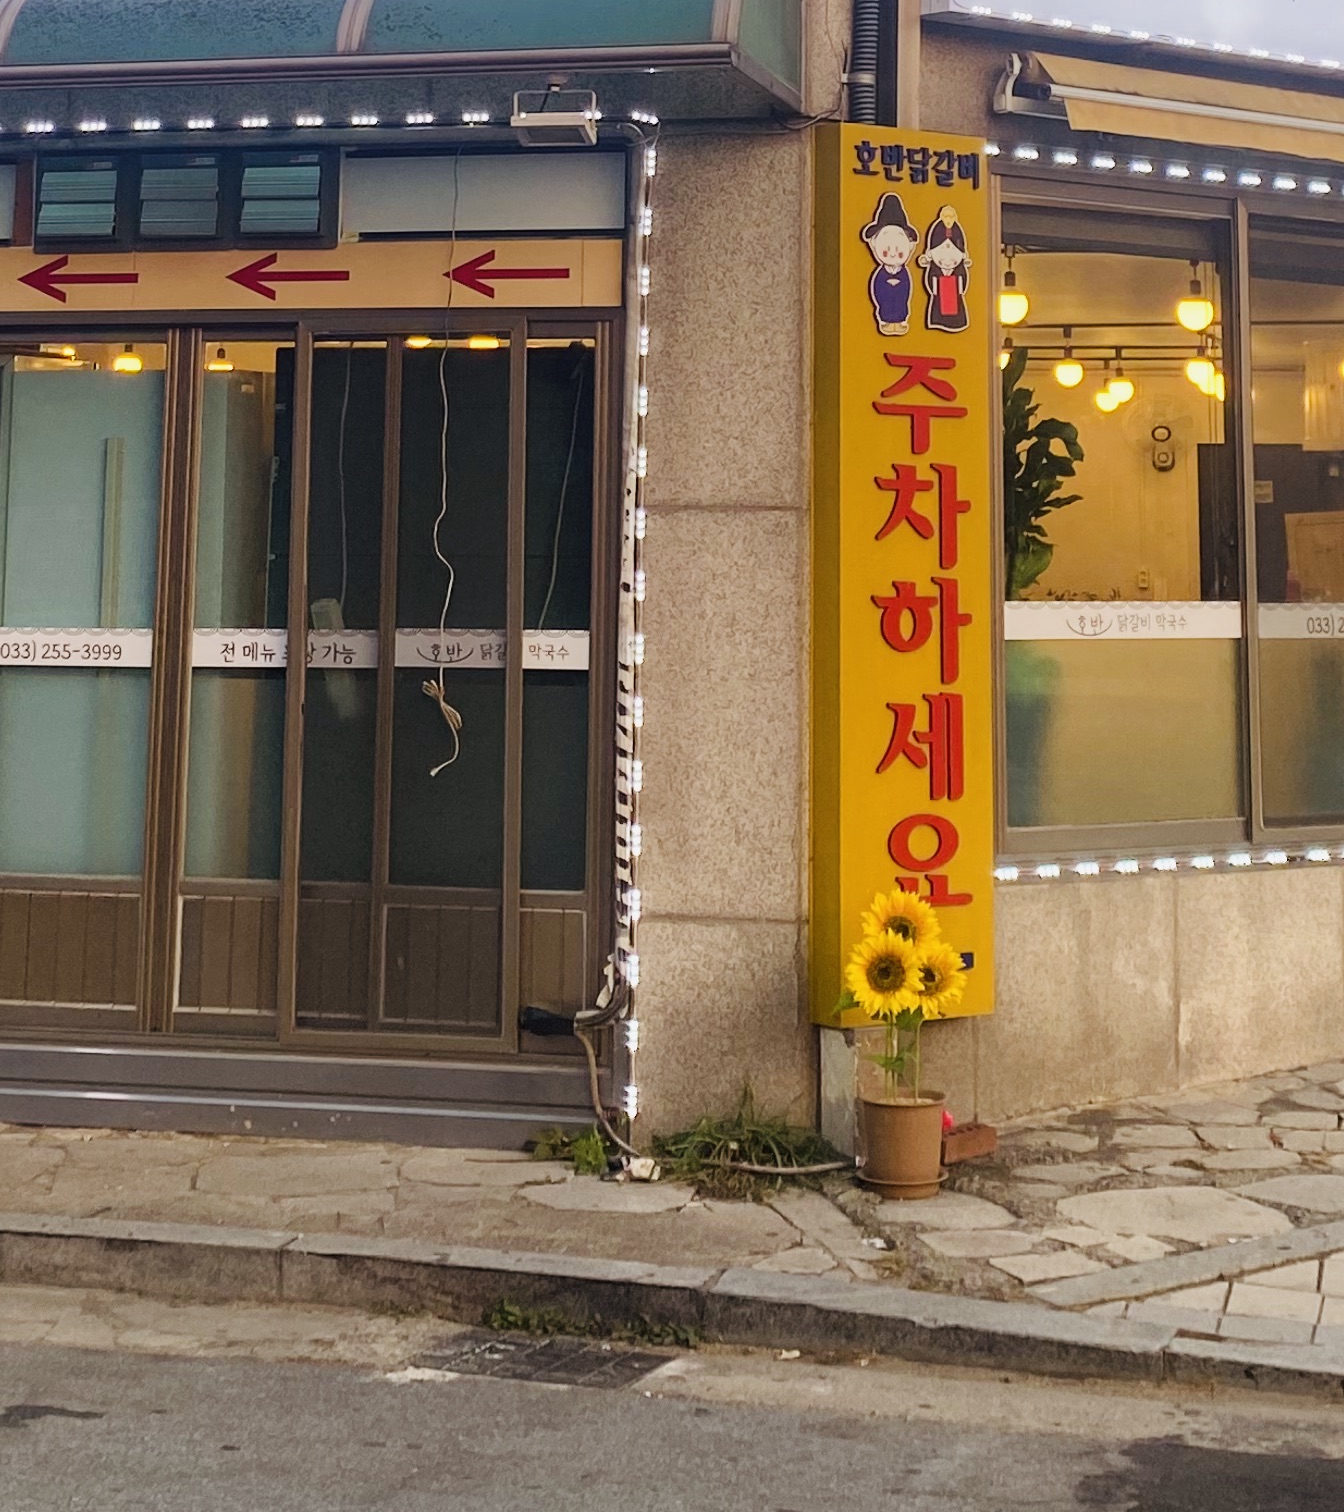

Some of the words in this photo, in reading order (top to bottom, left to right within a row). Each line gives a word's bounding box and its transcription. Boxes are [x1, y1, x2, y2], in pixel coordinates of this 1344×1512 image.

[852, 140, 980, 190] 호반닭갈비
[872, 352, 973, 908] 주차하세요
[1078, 614, 1103, 636] 호반
[1117, 614, 1151, 632] 닭갈비
[1156, 614, 1187, 631] 막국수
[220, 642, 236, 663] 전
[242, 642, 276, 663] 메뉴
[322, 642, 357, 665] 가능
[431, 642, 463, 663] 호반
[529, 643, 570, 661] 막국수
